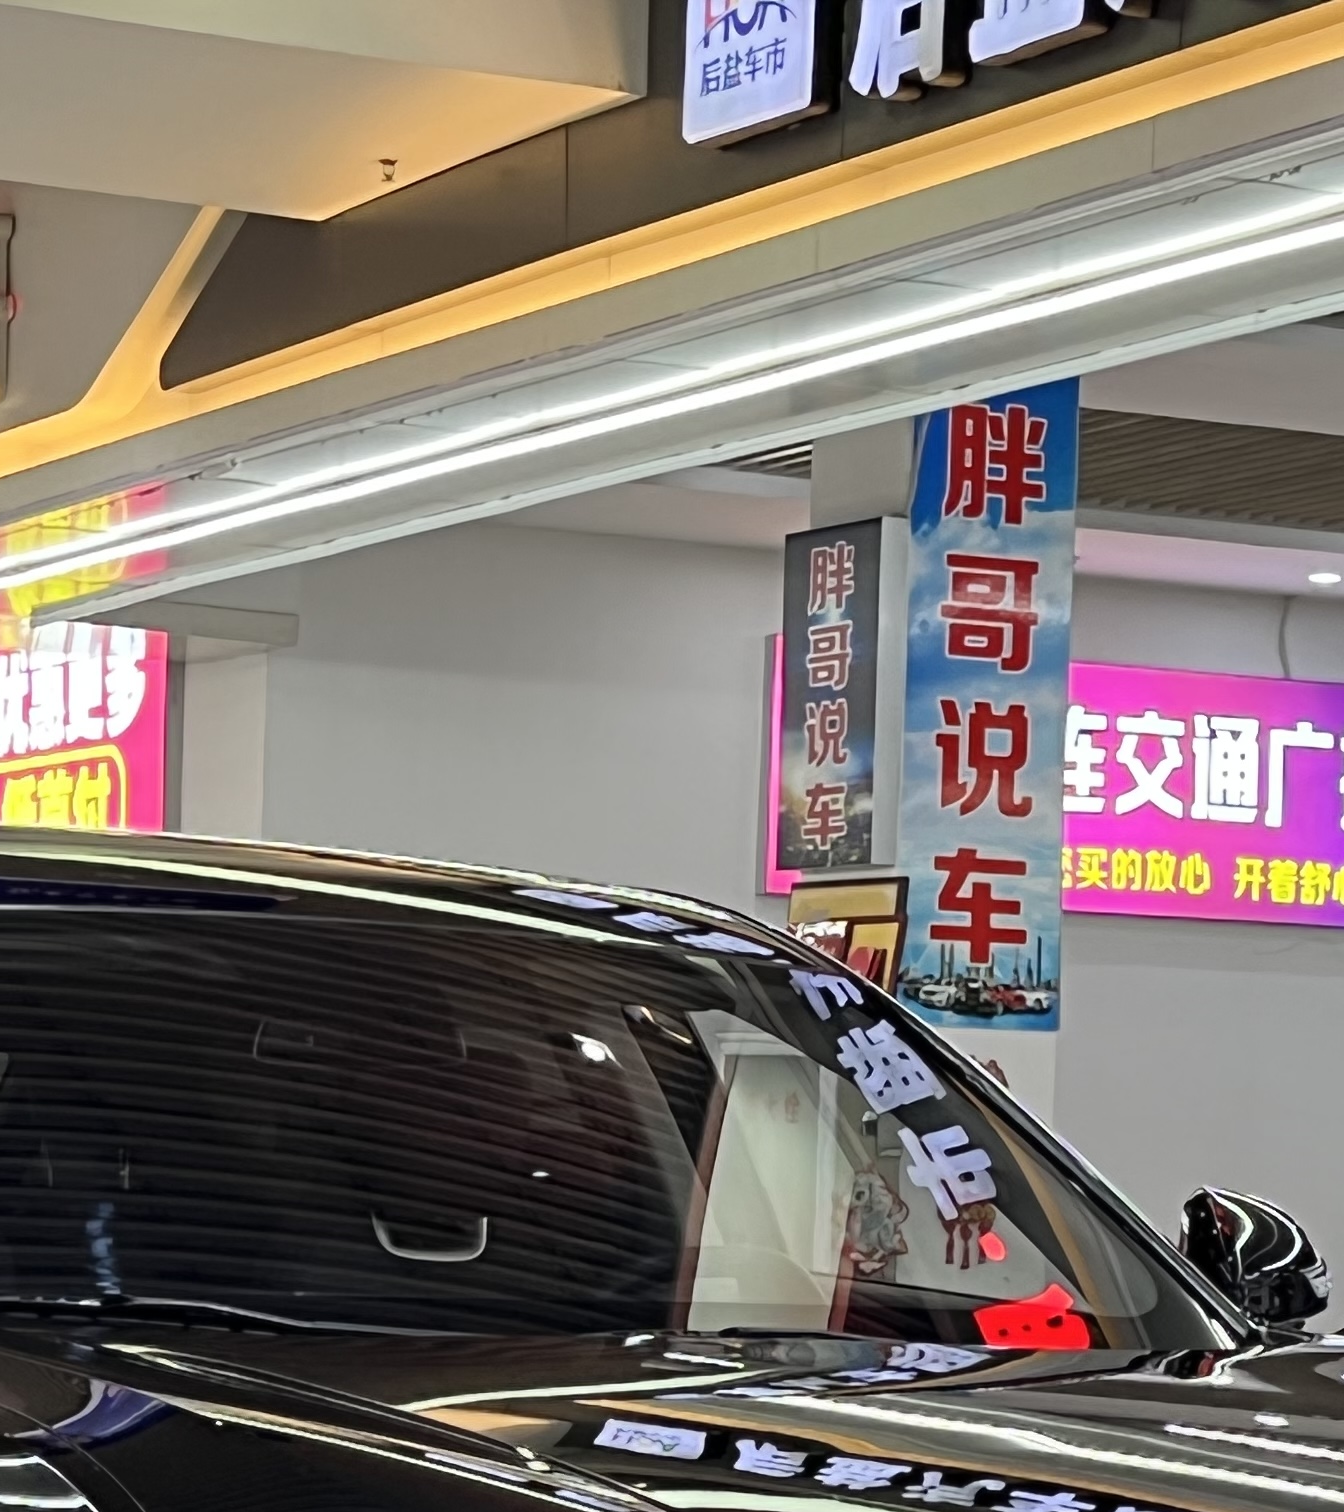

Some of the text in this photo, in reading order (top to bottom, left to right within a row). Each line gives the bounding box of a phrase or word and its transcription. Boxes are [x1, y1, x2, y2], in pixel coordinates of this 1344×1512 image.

[700, 38, 787, 97] 后盐车市
[801, 540, 855, 850] 胖哥说车
[929, 402, 1047, 965] 胖哥说车
